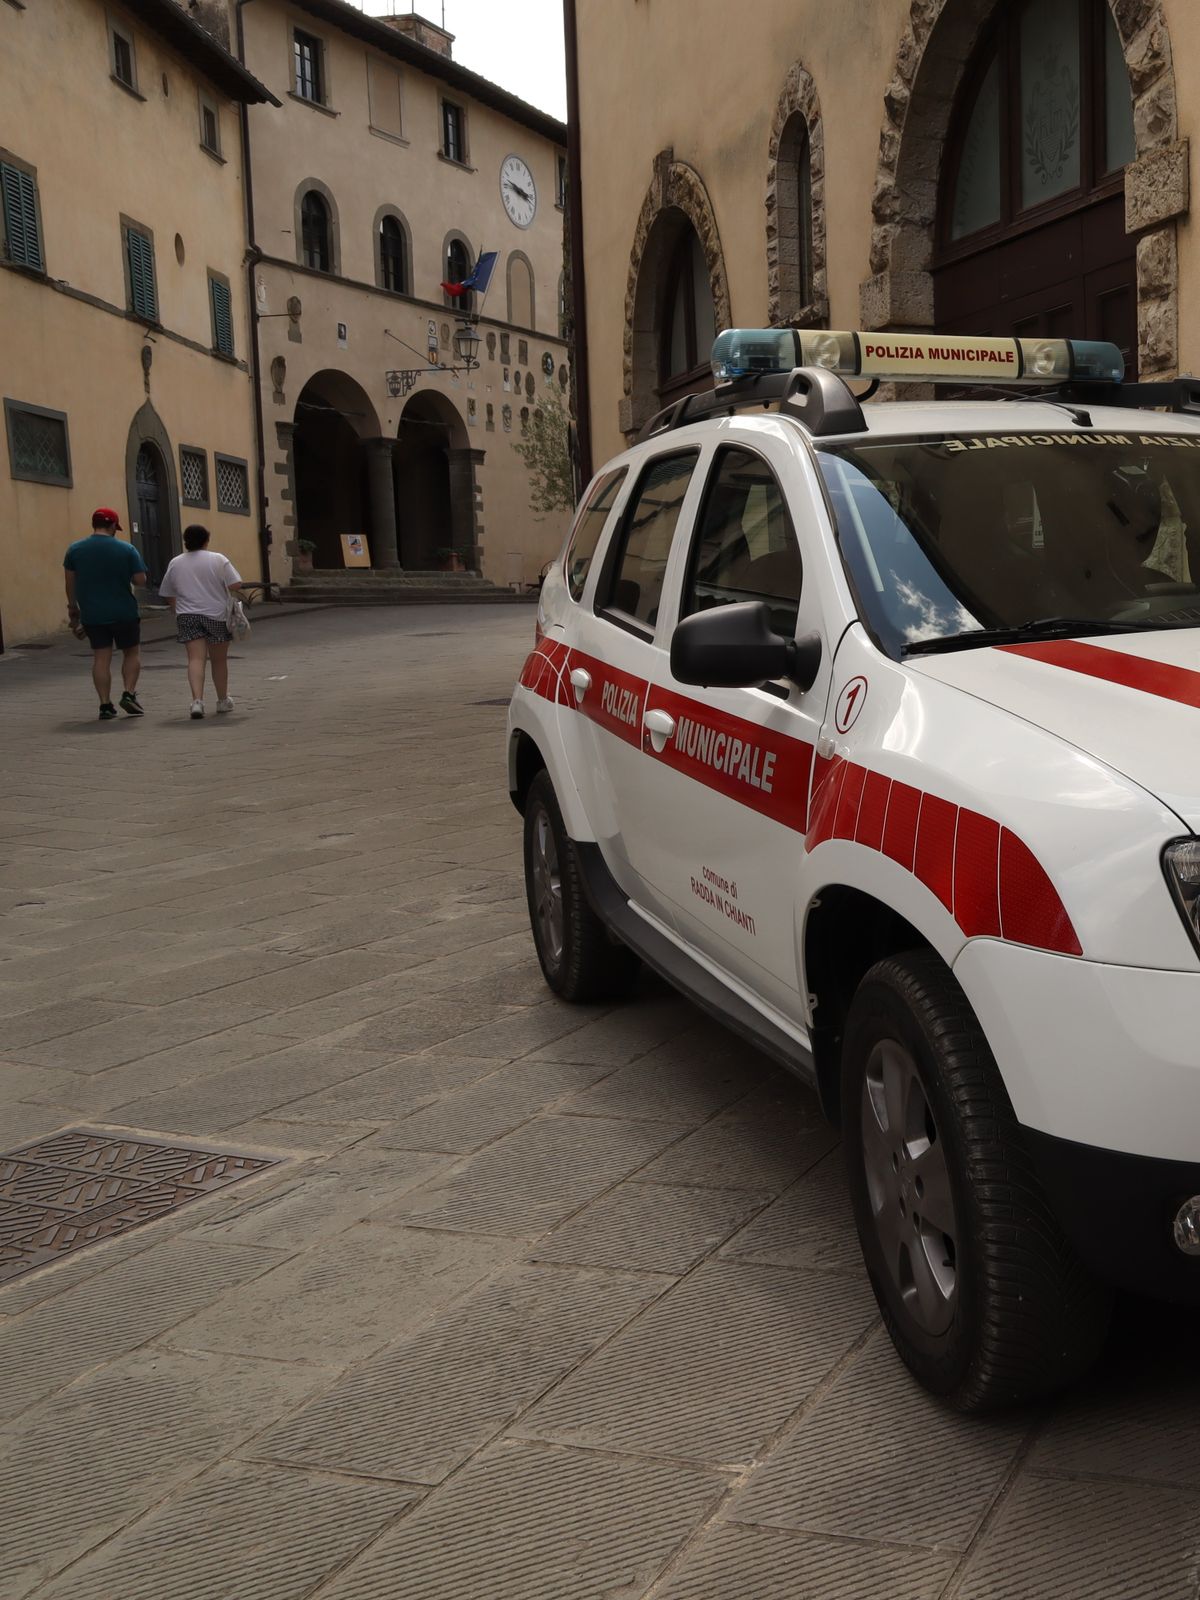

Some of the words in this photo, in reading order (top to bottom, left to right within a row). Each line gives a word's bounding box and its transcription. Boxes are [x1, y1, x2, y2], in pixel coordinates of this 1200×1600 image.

[866, 345, 924, 359] POLIZIA
[928, 347, 1014, 362] MUNICIPALE
[601, 680, 639, 728] POLIZIA
[843, 684, 861, 726] 1
[675, 715, 777, 794] MUNICIPALE
[702, 865, 729, 894] comune
[730, 881, 738, 900] di
[690, 875, 715, 908] RADDA
[724, 900, 756, 937] CHIANTI
